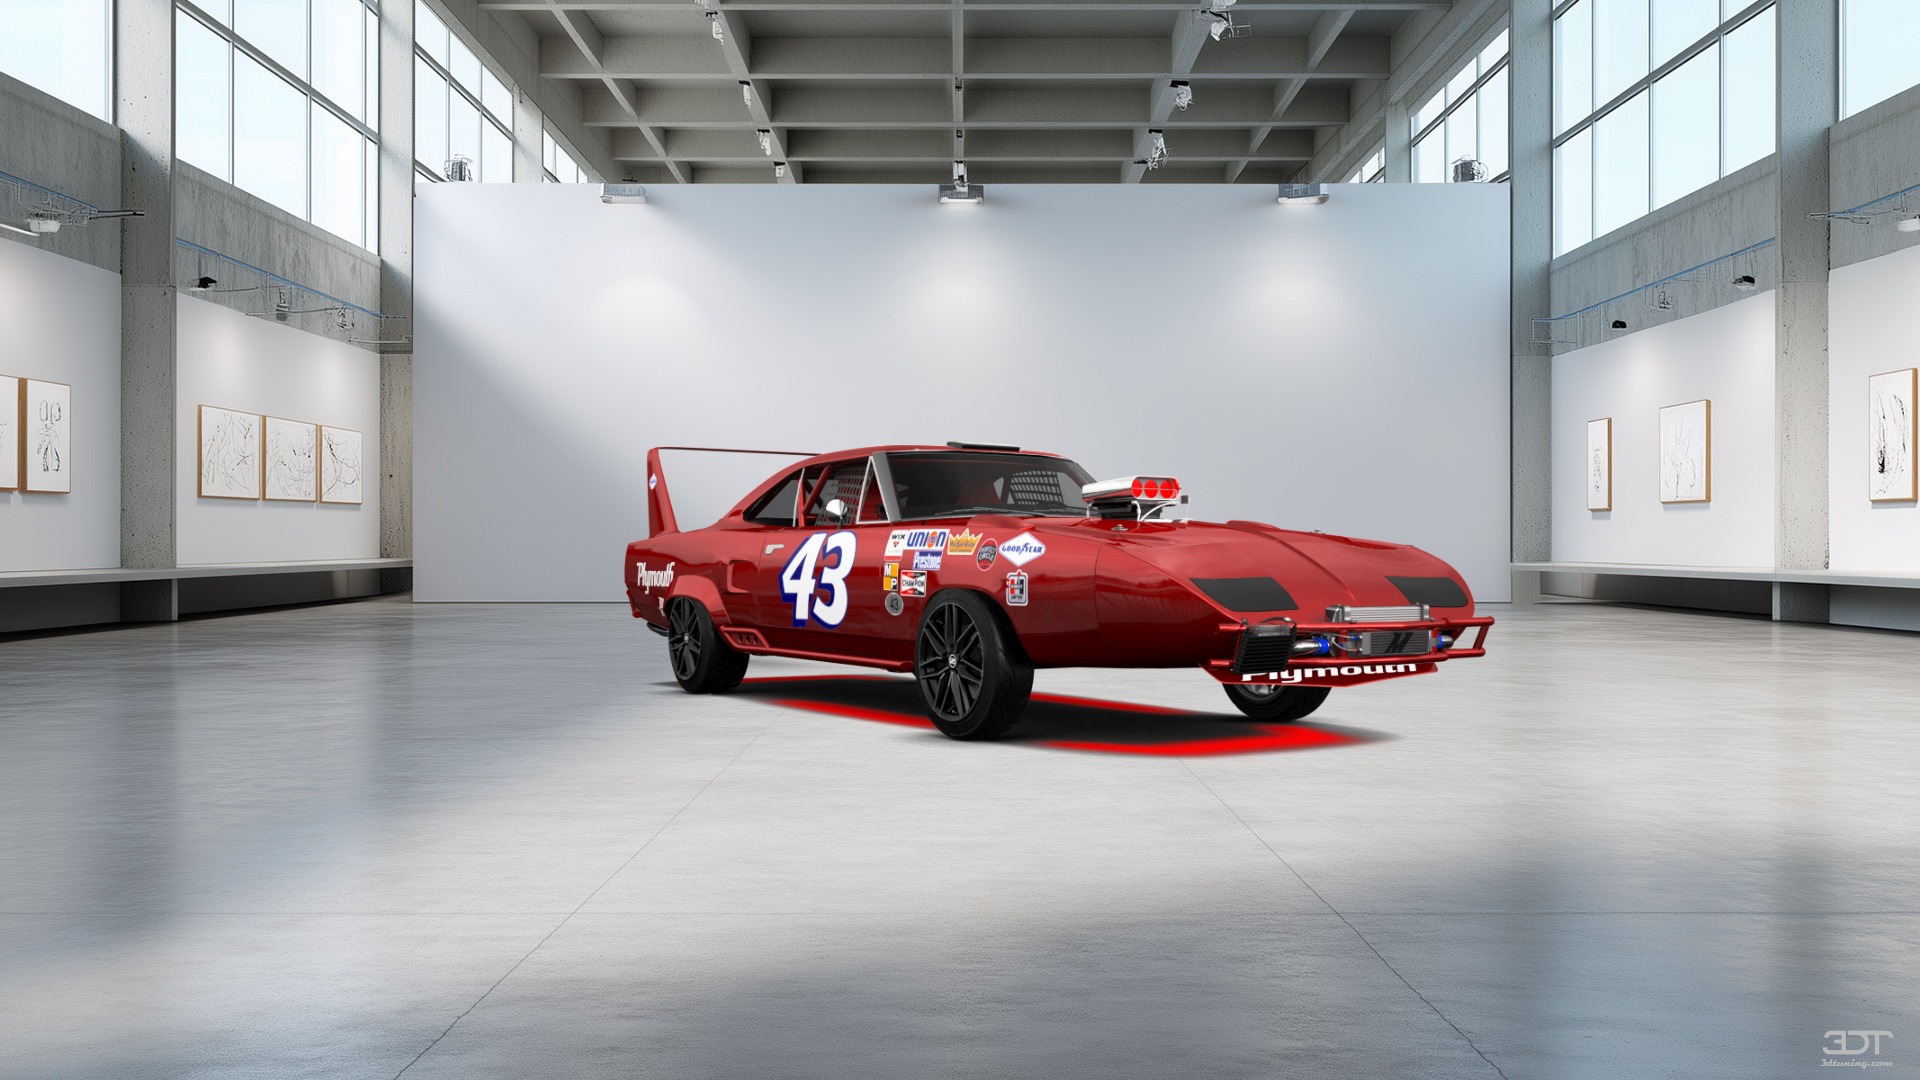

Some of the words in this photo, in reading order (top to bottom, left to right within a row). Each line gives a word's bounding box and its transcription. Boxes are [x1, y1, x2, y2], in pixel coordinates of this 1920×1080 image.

[907, 531, 948, 548] UNION
[636, 562, 676, 594] Plymouth
[779, 530, 857, 629] 43
[889, 597, 899, 611] 43
